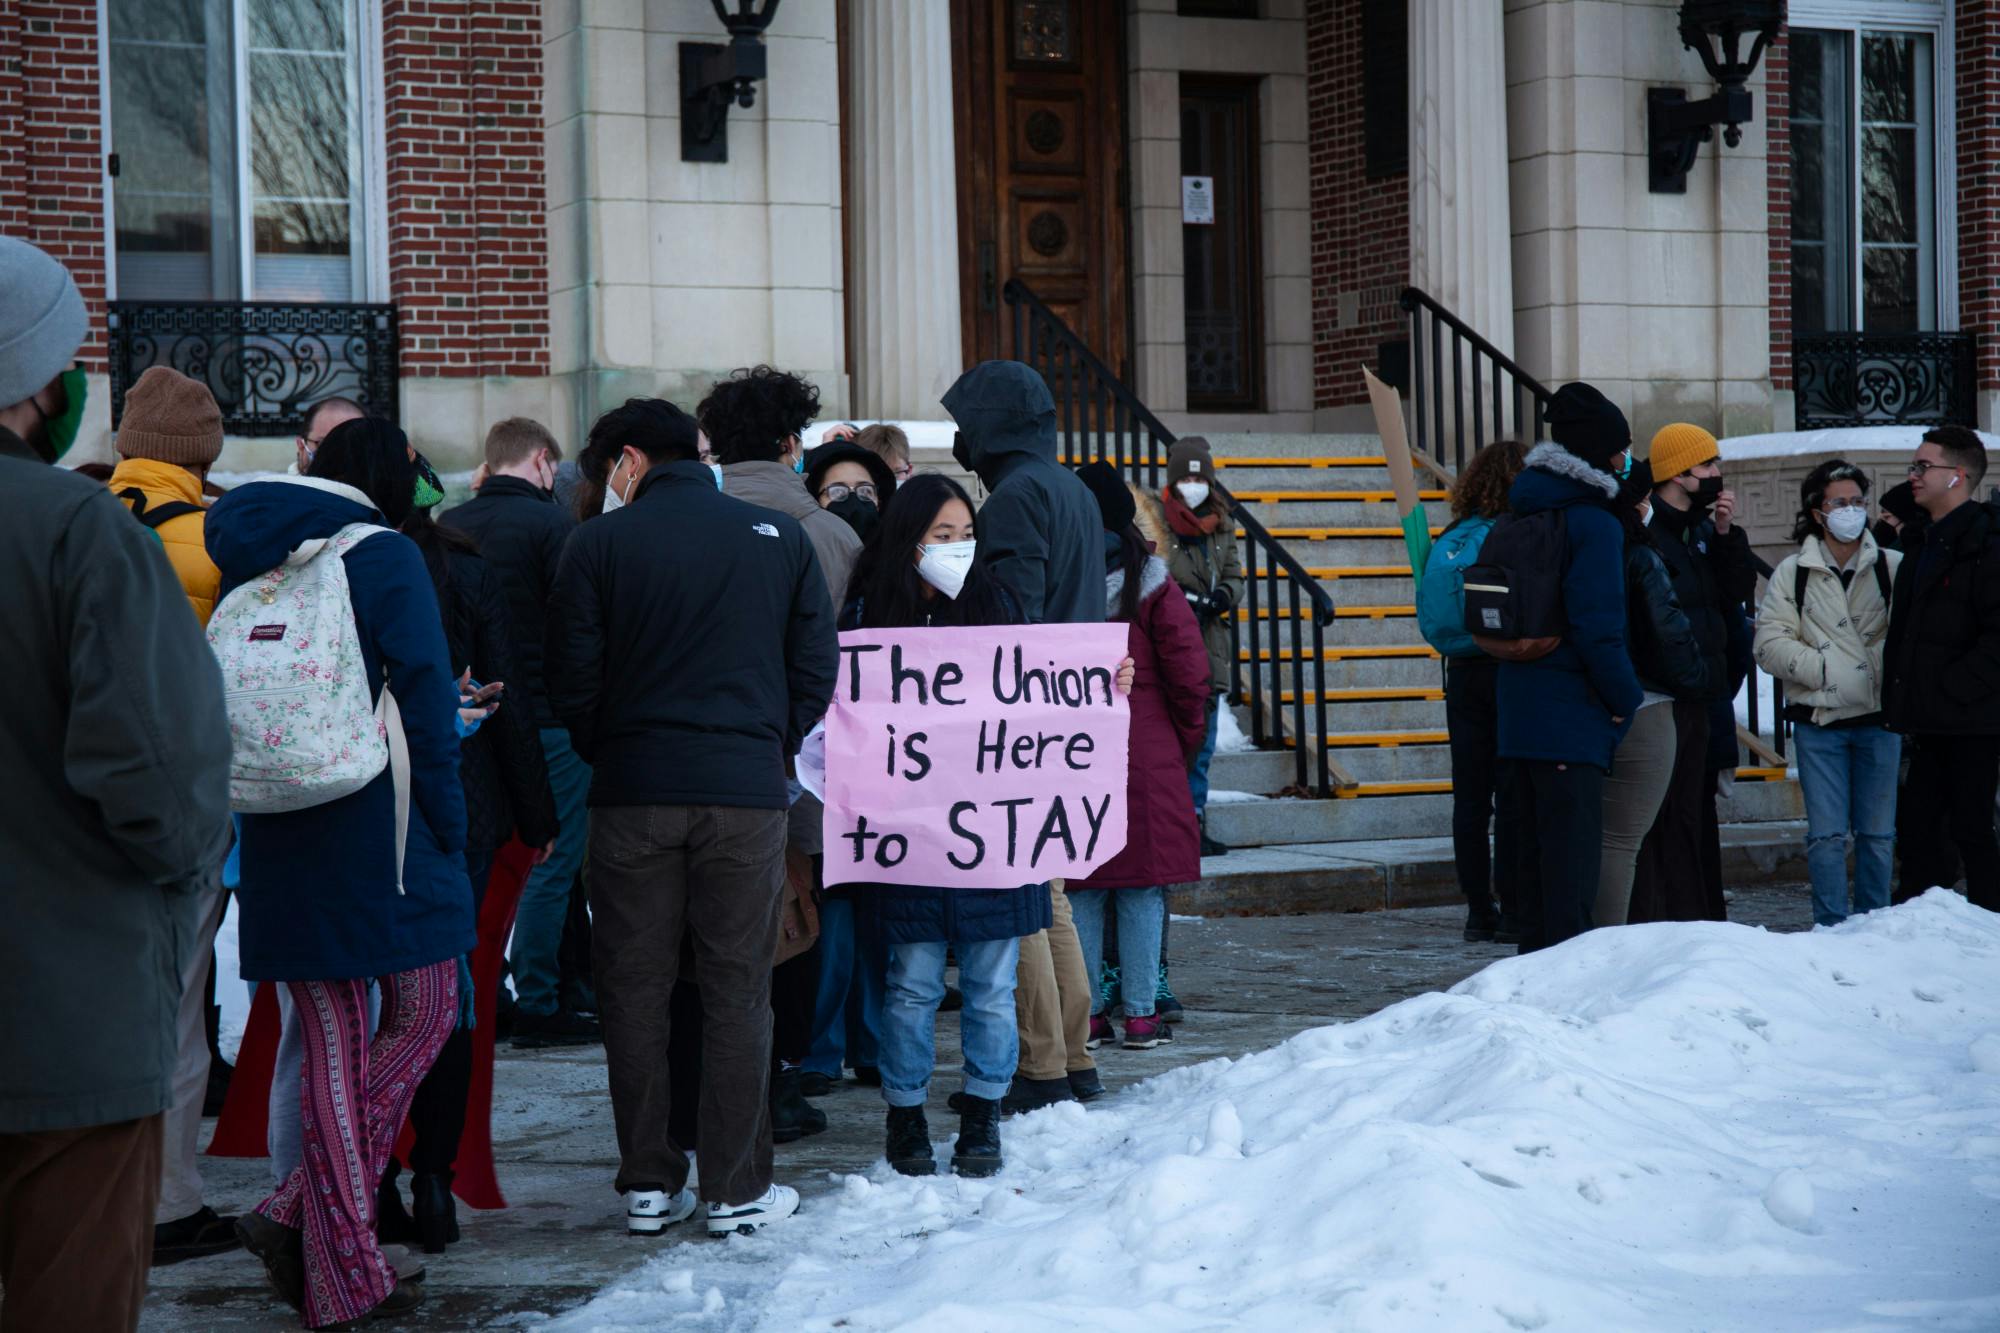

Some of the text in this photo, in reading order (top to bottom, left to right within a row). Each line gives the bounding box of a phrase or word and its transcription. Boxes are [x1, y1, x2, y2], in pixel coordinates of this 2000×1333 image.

[840, 644, 1113, 708] The Union
[886, 718, 1095, 781] is Here
[841, 793, 1111, 870] to STAY
